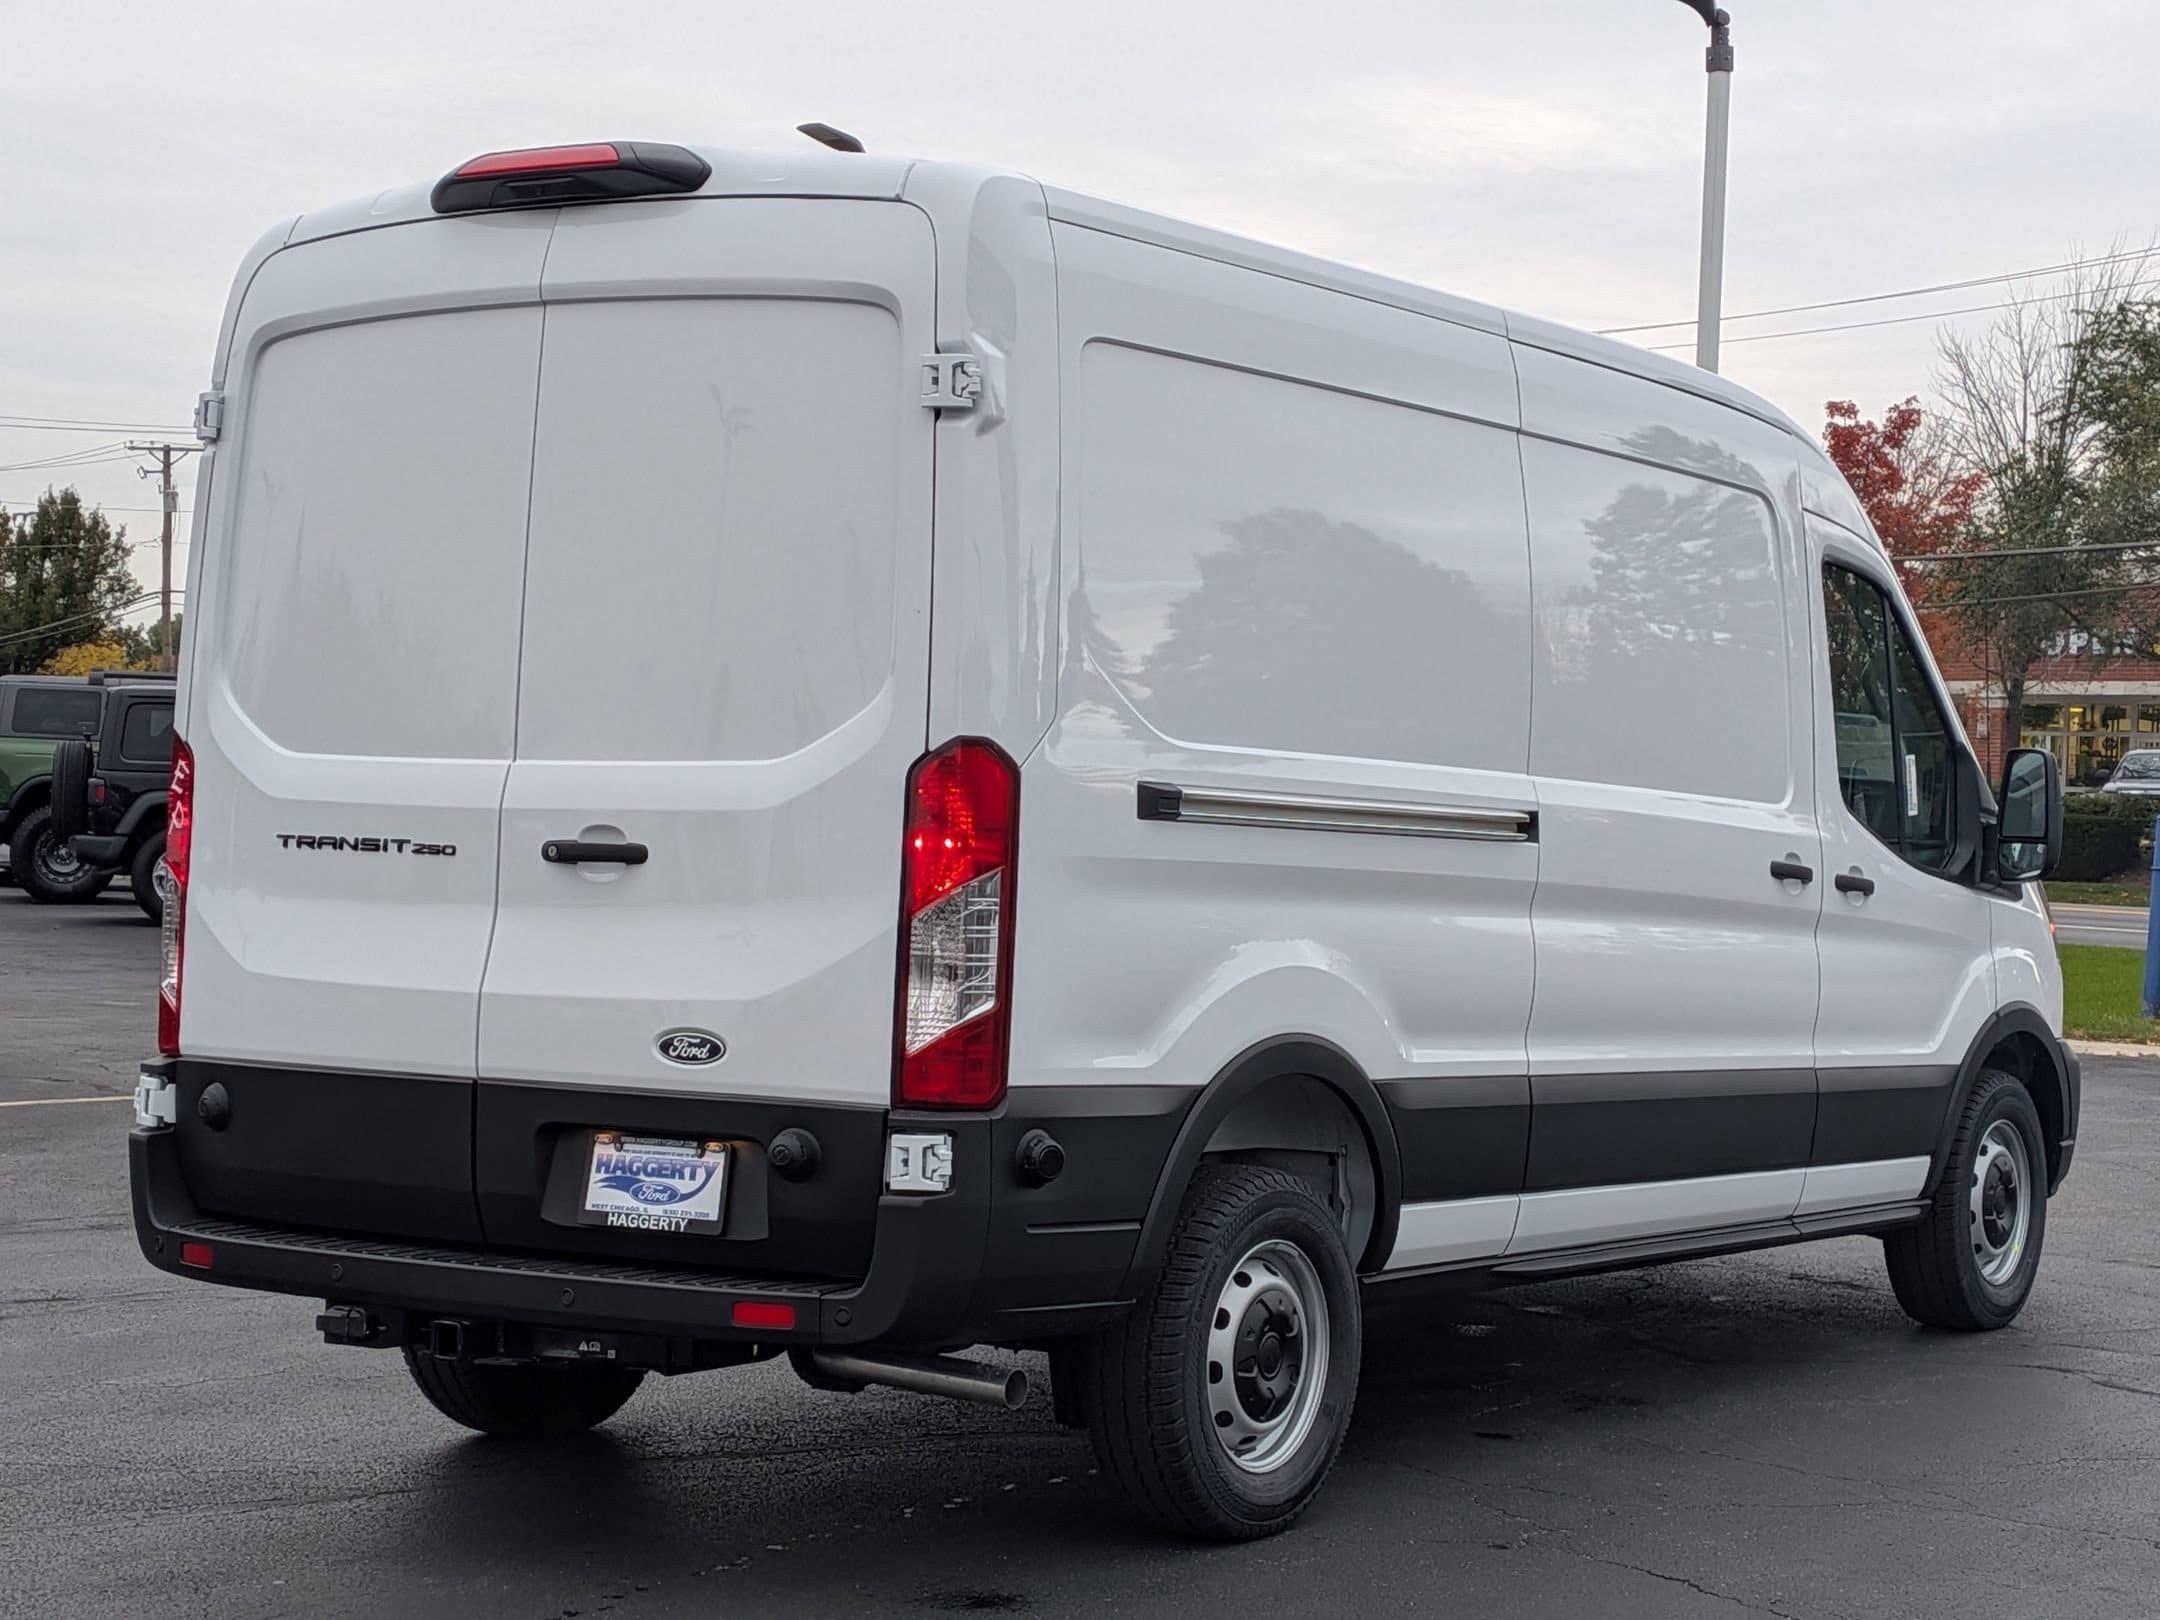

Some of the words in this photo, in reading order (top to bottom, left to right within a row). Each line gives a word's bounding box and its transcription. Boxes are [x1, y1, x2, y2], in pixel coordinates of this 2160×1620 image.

[276, 834, 411, 853] TRANSIT
[411, 843, 457, 856] 250
[668, 1036, 711, 1059] Ford
[594, 1153, 720, 1182] HAGGERTY
[637, 1185, 670, 1202] Ford
[591, 1203, 608, 1211] WEST
[607, 1212, 689, 1232] HAGGERTY
